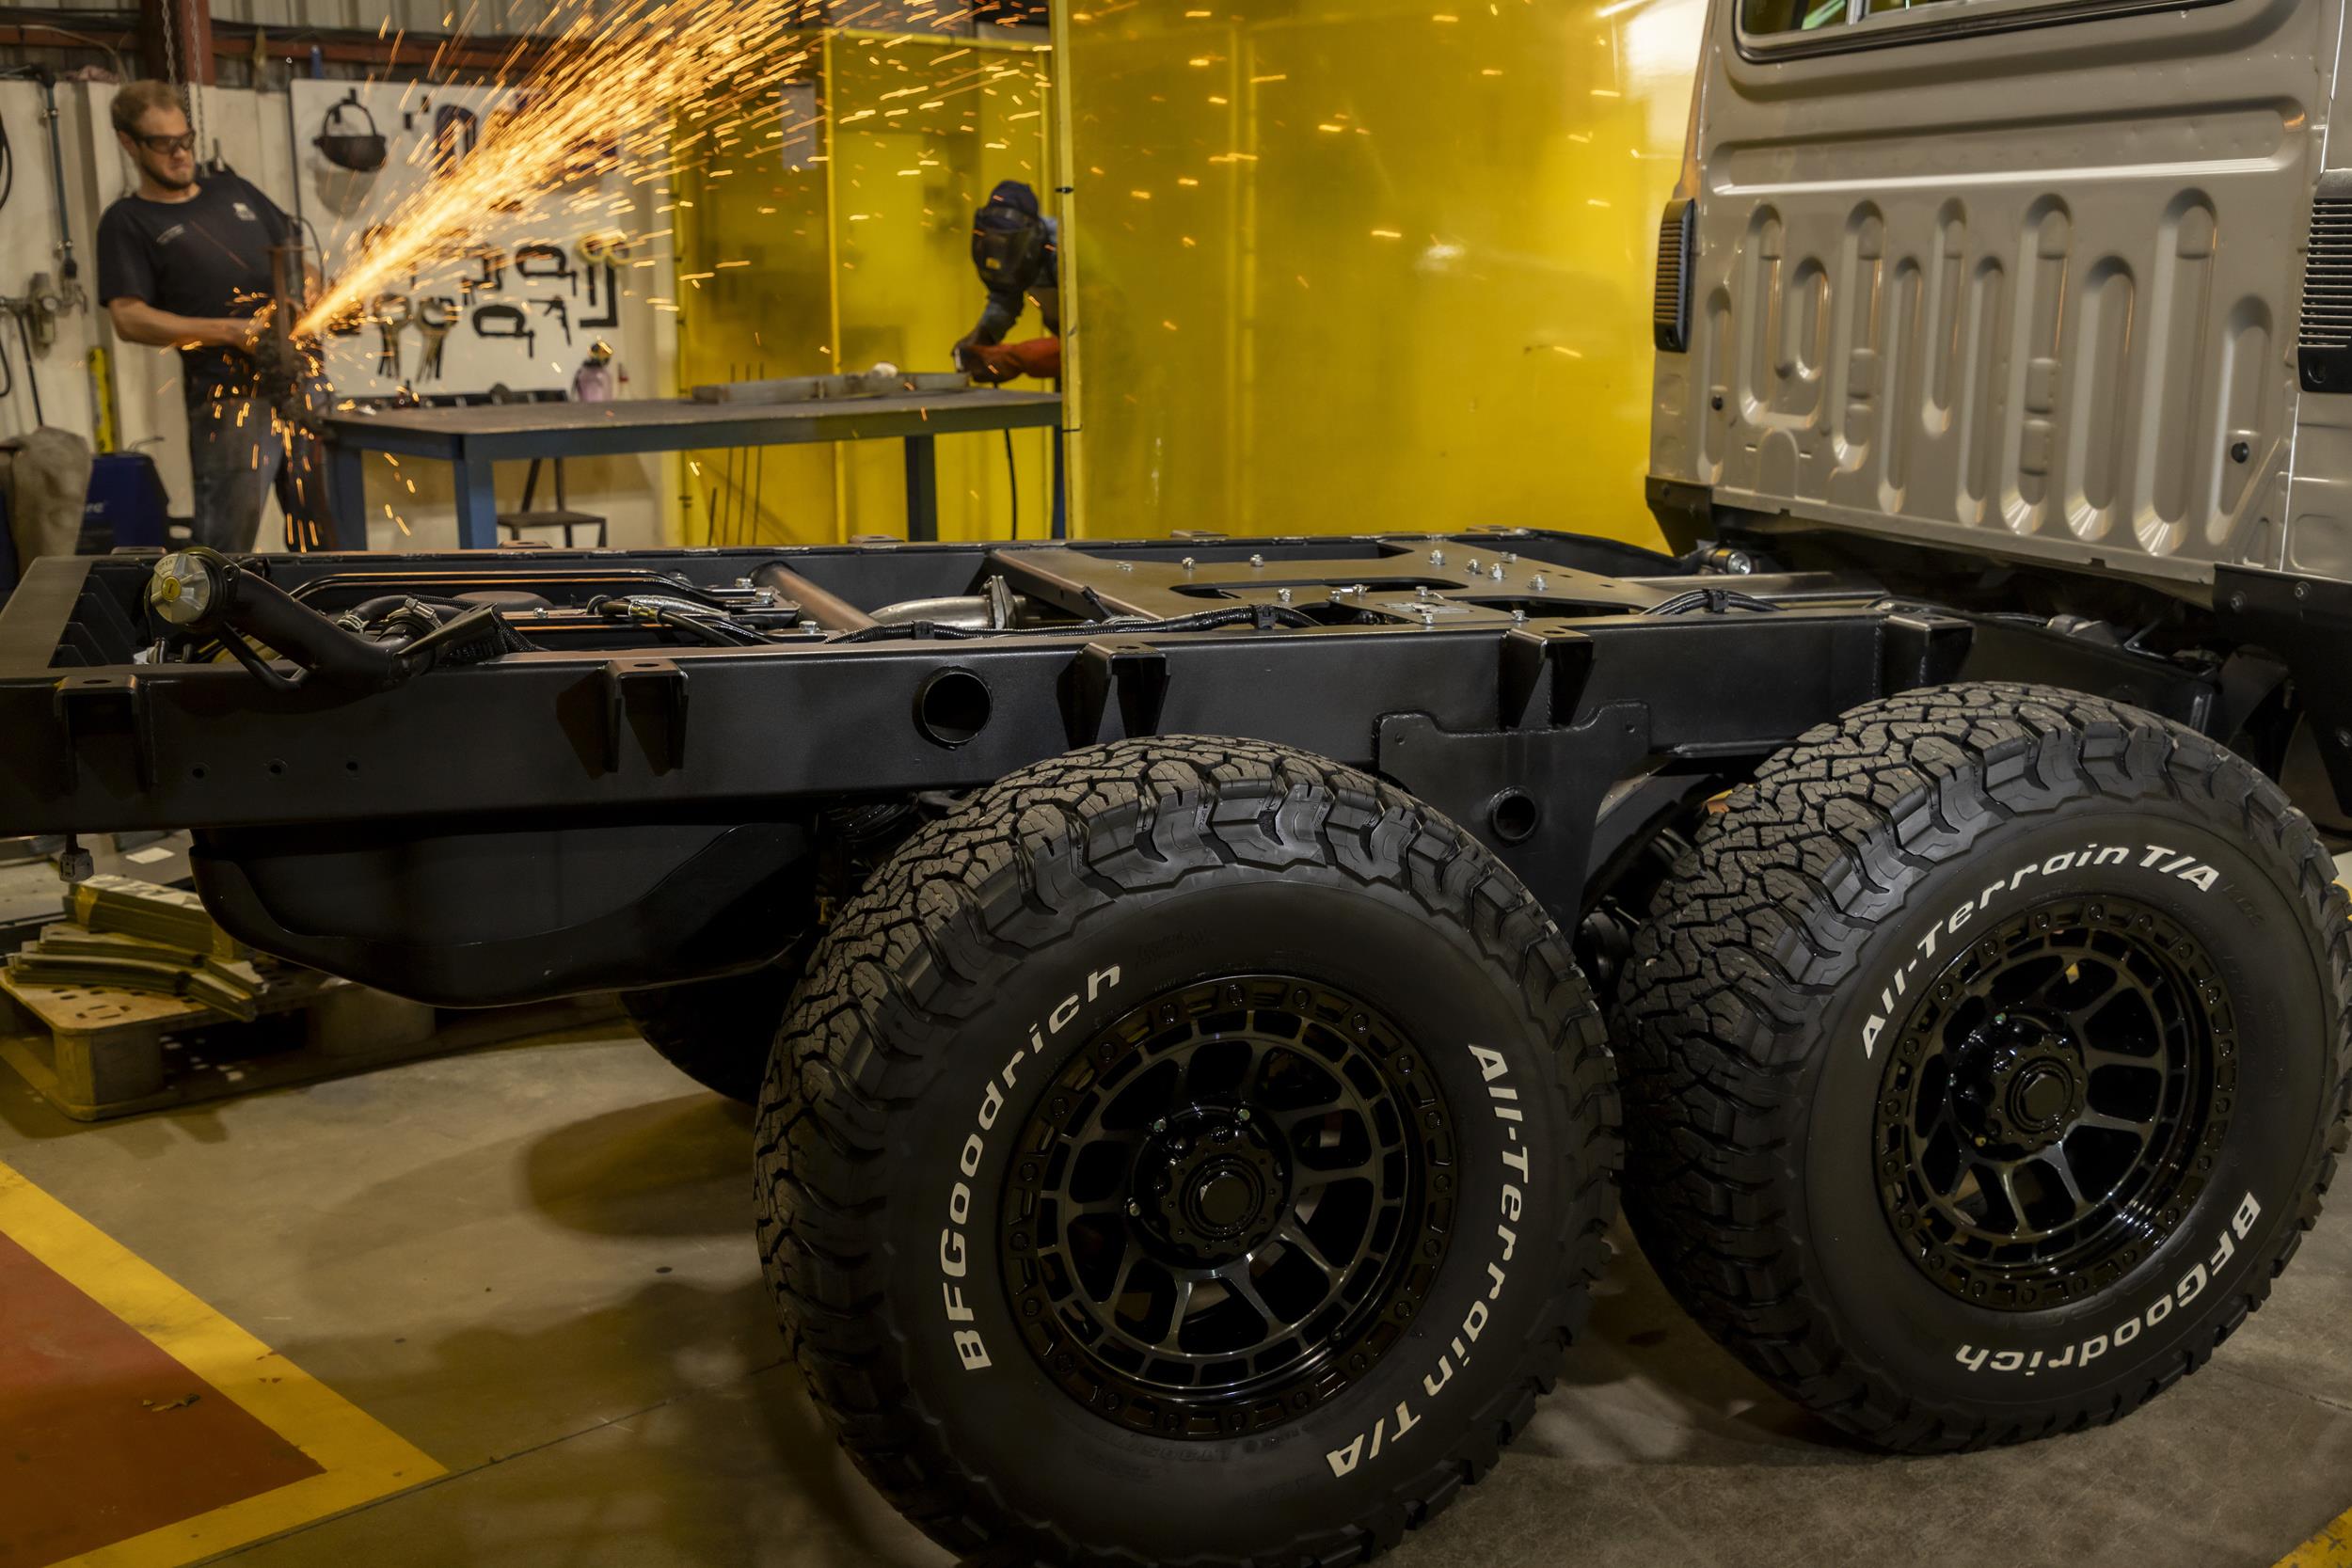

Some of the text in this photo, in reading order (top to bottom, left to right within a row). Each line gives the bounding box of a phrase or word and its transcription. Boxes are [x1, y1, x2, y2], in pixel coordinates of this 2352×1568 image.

[1862, 843, 2131, 1060] All-Terrain
[2138, 844, 2220, 893] T/A
[940, 963, 1120, 1370] BFGoodrich
[1326, 1043, 1529, 1478] All-Terrain T/A
[1955, 1191, 2262, 1377] BFGoodrich
